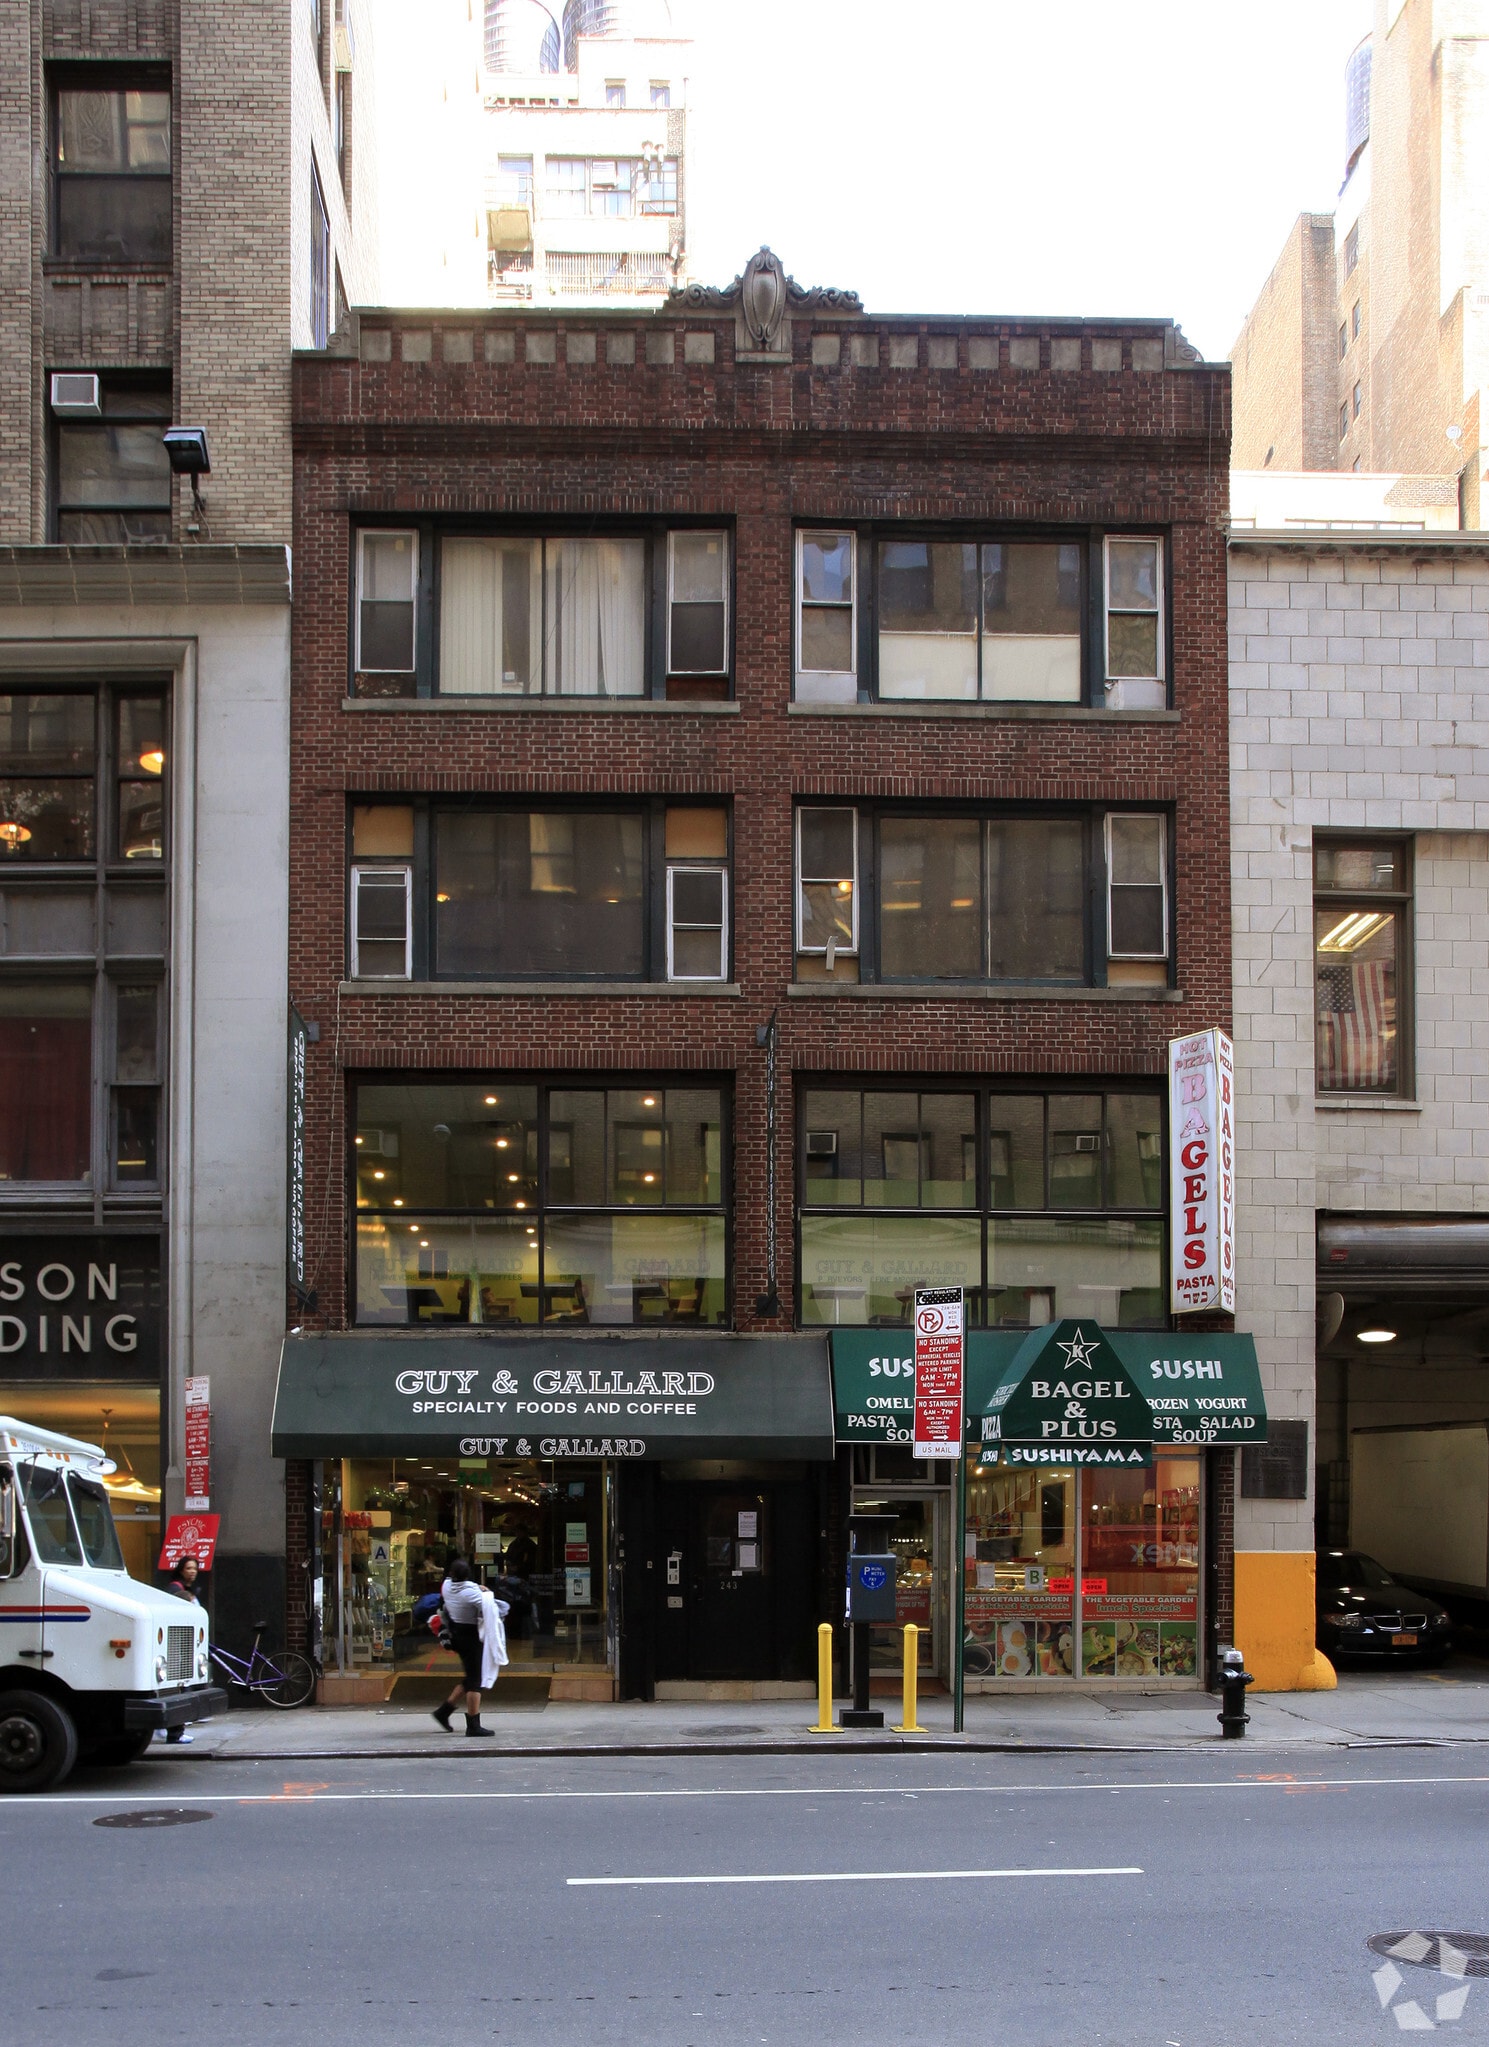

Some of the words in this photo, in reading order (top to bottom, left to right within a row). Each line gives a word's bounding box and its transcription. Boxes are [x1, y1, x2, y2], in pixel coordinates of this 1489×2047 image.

[1180, 1038, 1207, 1055] HOT
[1221, 1040, 1230, 1055] HOT
[1175, 1052, 1213, 1072] PIZZA
[1220, 1053, 1232, 1073] PIZZA
[1180, 1073, 1210, 1270] BAGELS
[1222, 1074, 1233, 1270] BAGELS
[816, 1260, 854, 1274] GUY
[861, 1260, 874, 1274] &
[881, 1260, 968, 1275] GALLARD
[0, 1262, 118, 1301] SON
[1176, 1274, 1215, 1290] PASTA
[0, 1314, 137, 1352] DING
[1072, 1345, 1084, 1358] K
[868, 1358, 915, 1378] SUS
[1150, 1360, 1223, 1379] SUSHI
[395, 1370, 478, 1394] GUY
[492, 1369, 518, 1394] &
[533, 1370, 715, 1396] GALLARD
[1031, 1381, 1131, 1398] BAGEL
[412, 1401, 507, 1413] SPECIALTY
[516, 1402, 577, 1414] FOODS
[584, 1402, 620, 1414] AND
[627, 1403, 697, 1415] COFFEE
[866, 1397, 914, 1409] OMEL
[1064, 1401, 1087, 1418] &
[1146, 1398, 1189, 1410] ROZEN
[1194, 1398, 1247, 1409] YOGURT
[847, 1415, 897, 1428] PASTA
[982, 1415, 1001, 1440] PIZZA
[1041, 1421, 1117, 1438] PLUS
[1152, 1416, 1182, 1429] STA
[1200, 1416, 1256, 1429] SALAD
[886, 1429, 914, 1441] SO
[1172, 1430, 1218, 1442] SOUP
[459, 1438, 508, 1455] GUY
[515, 1438, 531, 1456] &
[540, 1438, 646, 1456] GALLARD
[1012, 1448, 1143, 1462] SUSHIYAMA
[375, 1546, 387, 1559] A
[720, 1581, 738, 1589] 243
[1030, 1570, 1039, 1584] B
[1132, 1604, 1181, 1613] Specials
